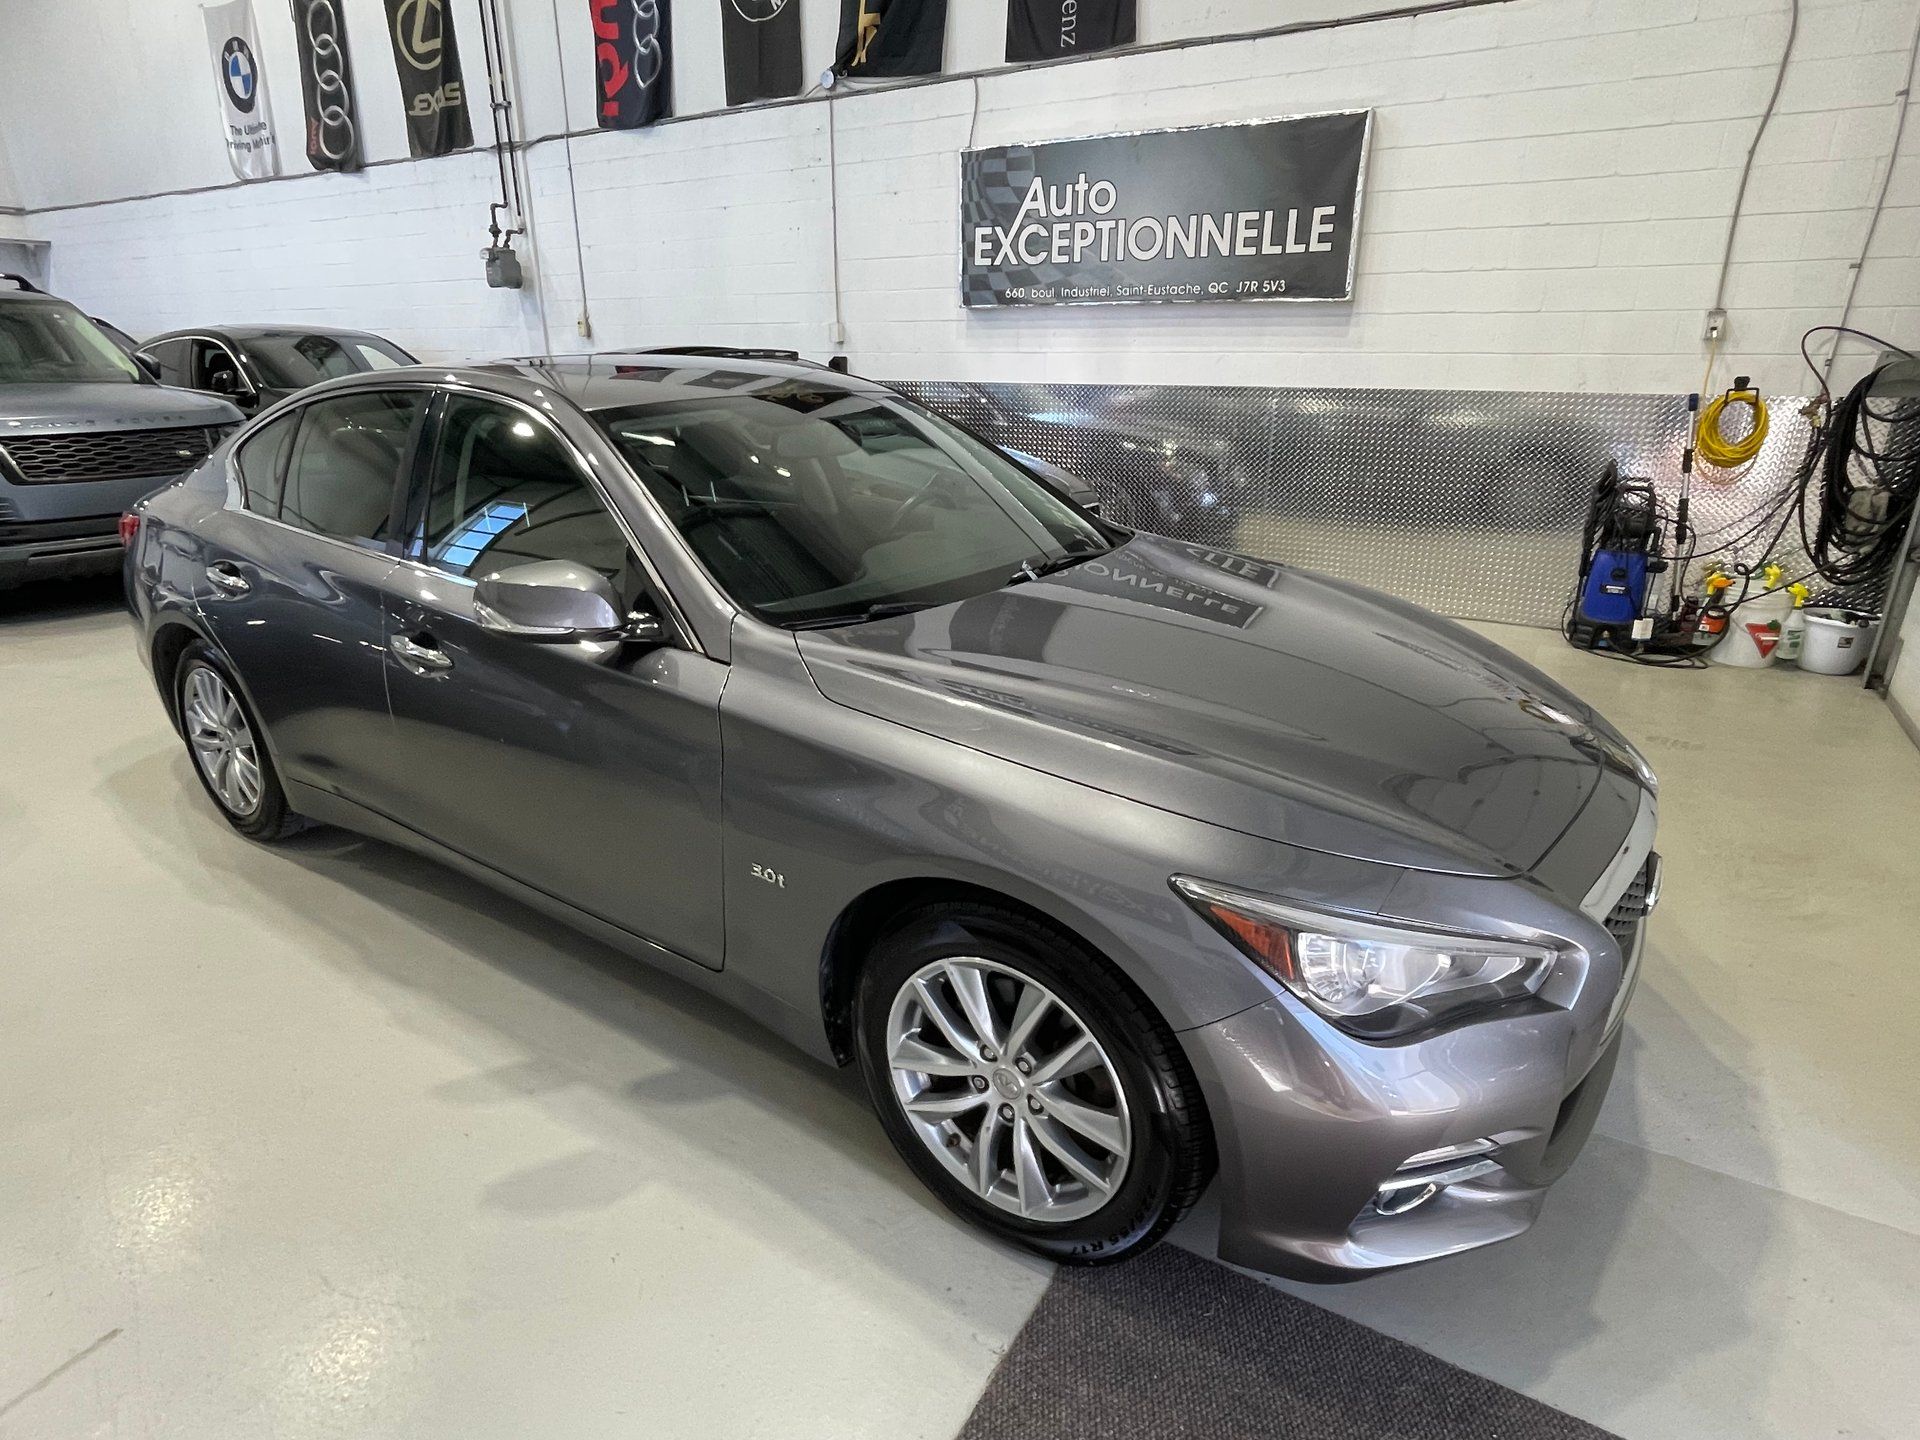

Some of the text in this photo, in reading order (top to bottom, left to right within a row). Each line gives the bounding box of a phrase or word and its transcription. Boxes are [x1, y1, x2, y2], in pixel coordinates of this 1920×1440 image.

[1018, 171, 1118, 220] Auto
[974, 205, 1336, 267] EXCEPTIONNELLE
[1208, 281, 1229, 294] QC
[1236, 280, 1258, 293] J7R
[1263, 279, 1286, 293] 5V3
